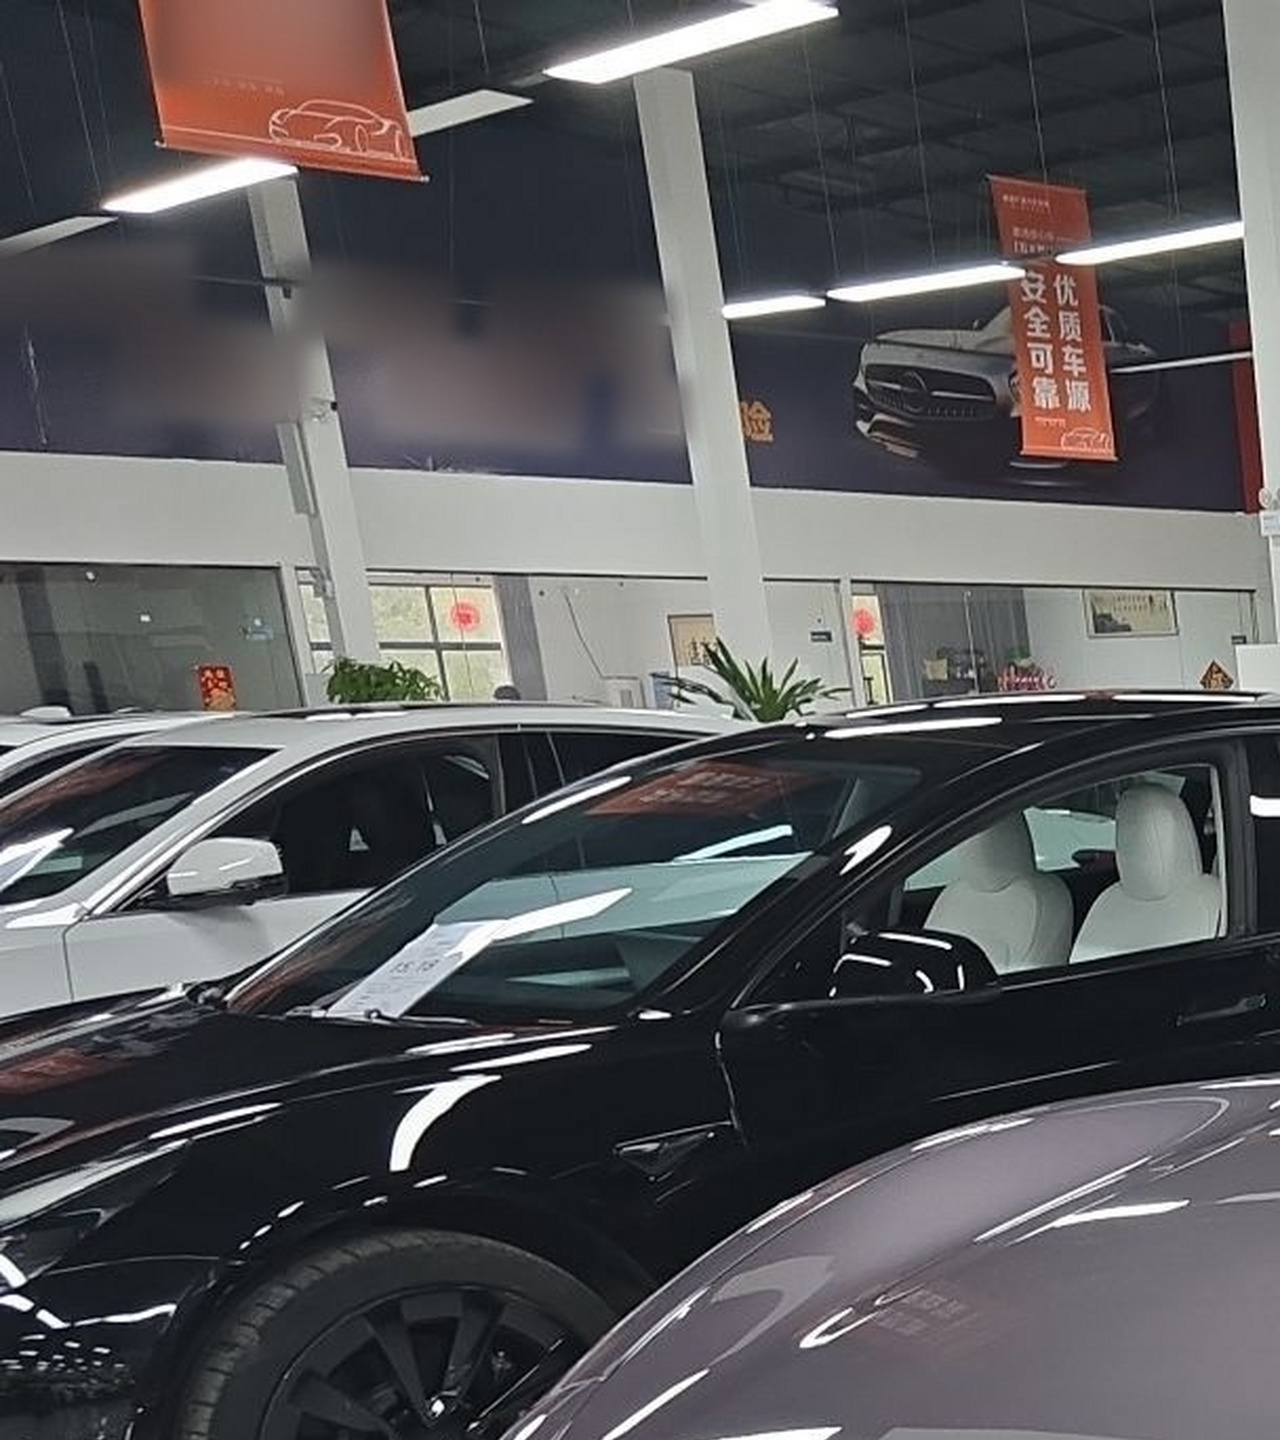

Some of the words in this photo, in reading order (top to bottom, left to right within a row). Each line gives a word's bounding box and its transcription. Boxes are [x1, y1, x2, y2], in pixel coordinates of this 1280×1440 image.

[1021, 272, 1060, 410] 安全可靠
[1054, 273, 1092, 412] 优质车源
